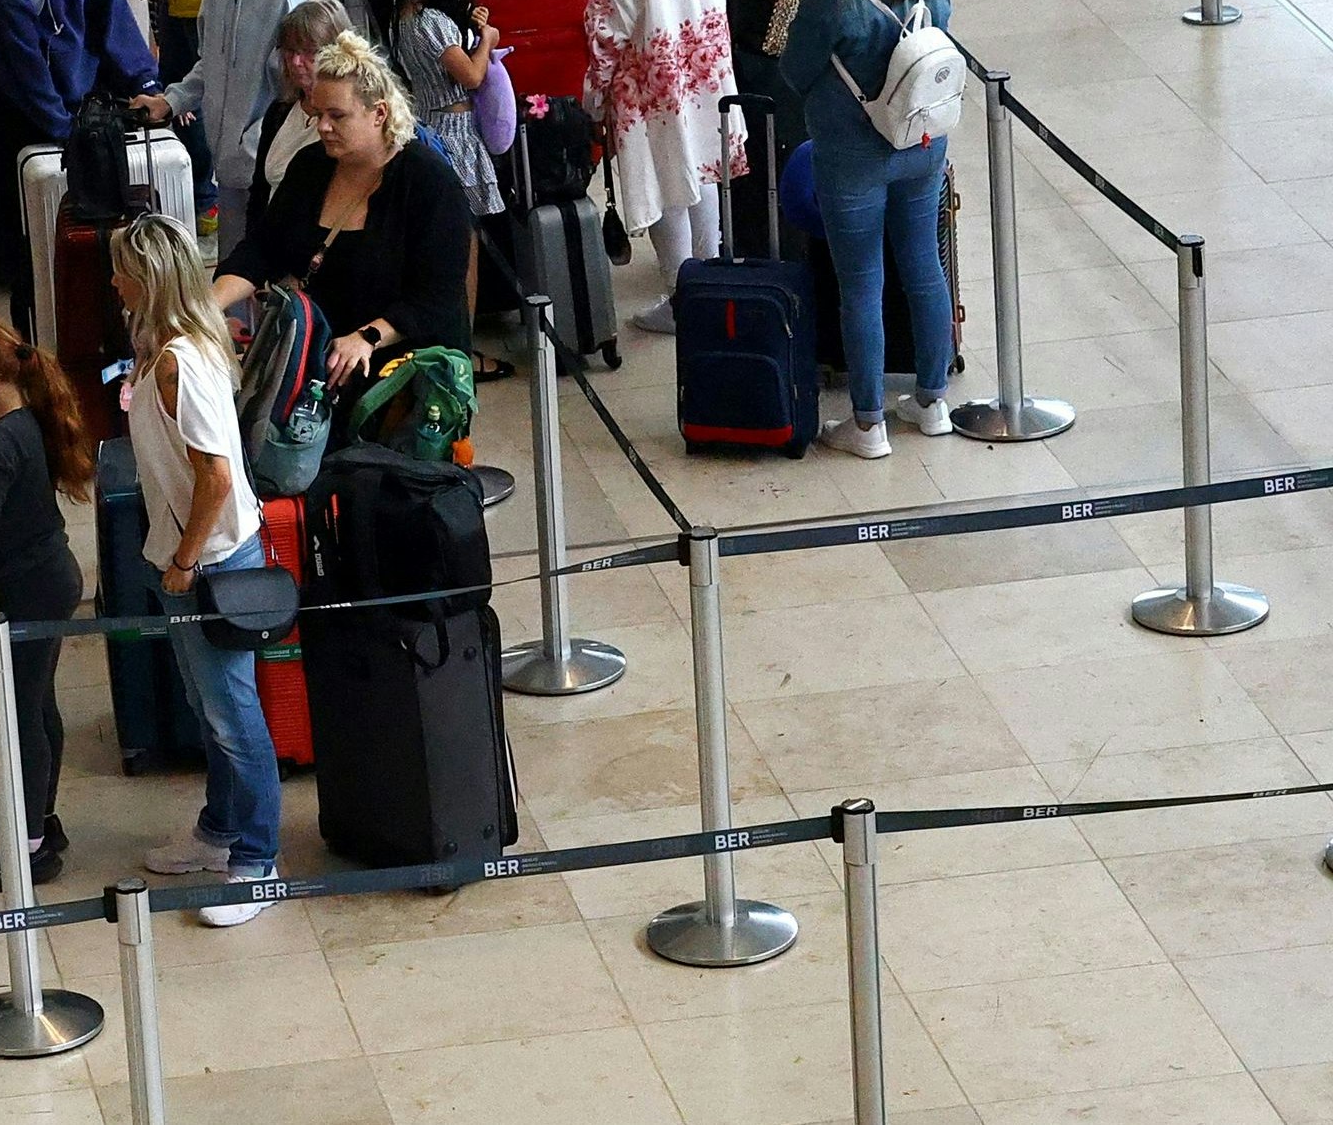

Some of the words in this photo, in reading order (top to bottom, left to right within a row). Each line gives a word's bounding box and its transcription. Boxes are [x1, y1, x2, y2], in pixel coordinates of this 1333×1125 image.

[1264, 476, 1295, 494] BER
[1062, 502, 1093, 520] BER
[857, 523, 889, 541] BER
[582, 557, 613, 572] BER
[170, 614, 202, 624] BER
[1023, 806, 1058, 818] BER
[715, 831, 750, 850] BER
[484, 858, 520, 877] BER
[252, 882, 288, 900] BER
